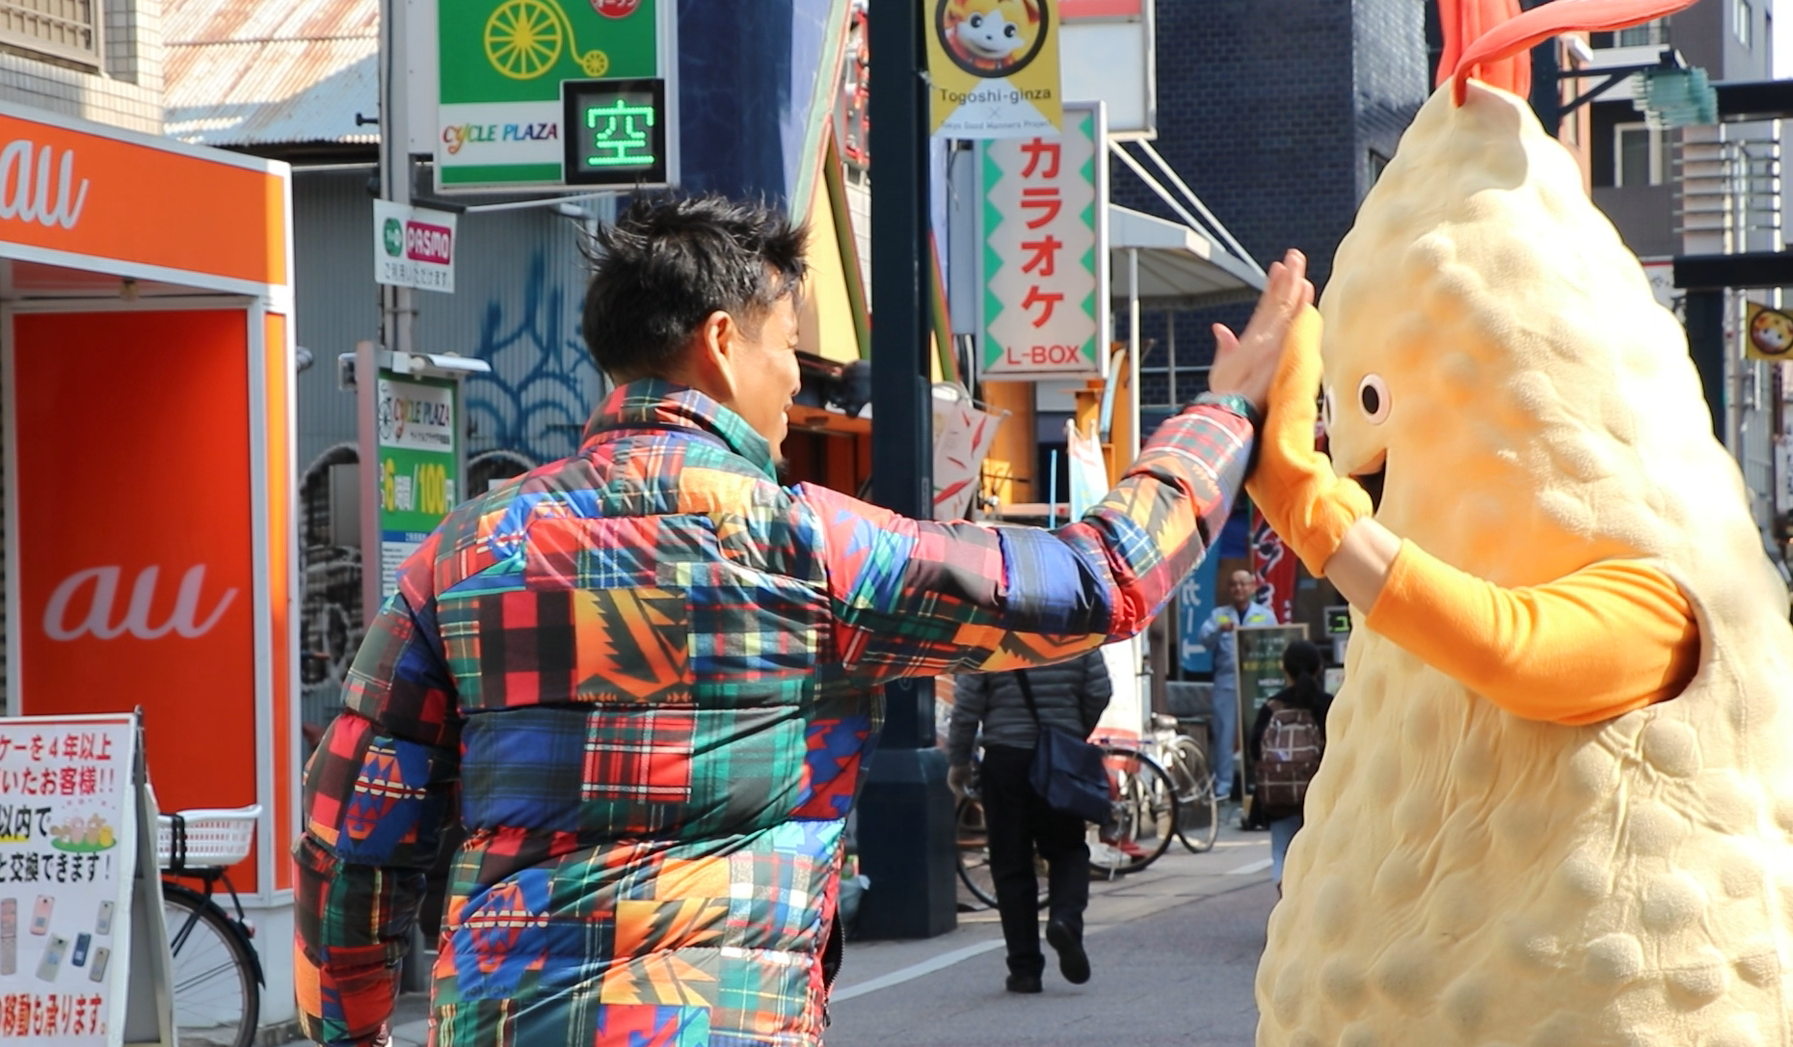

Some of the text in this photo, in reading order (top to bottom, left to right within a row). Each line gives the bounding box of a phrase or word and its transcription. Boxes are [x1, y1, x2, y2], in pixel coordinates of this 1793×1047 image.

[940, 88, 1051, 105] Togoshi-ginza
[502, 122, 558, 141] PLAZA
[587, 99, 654, 166] 空
[0, 138, 90, 230] au
[406, 226, 451, 261] PASMO
[1020, 137, 1065, 329] カラオケ
[1006, 344, 1080, 366] L-BOX
[423, 401, 451, 428] PLAZA
[42, 564, 239, 642] au
